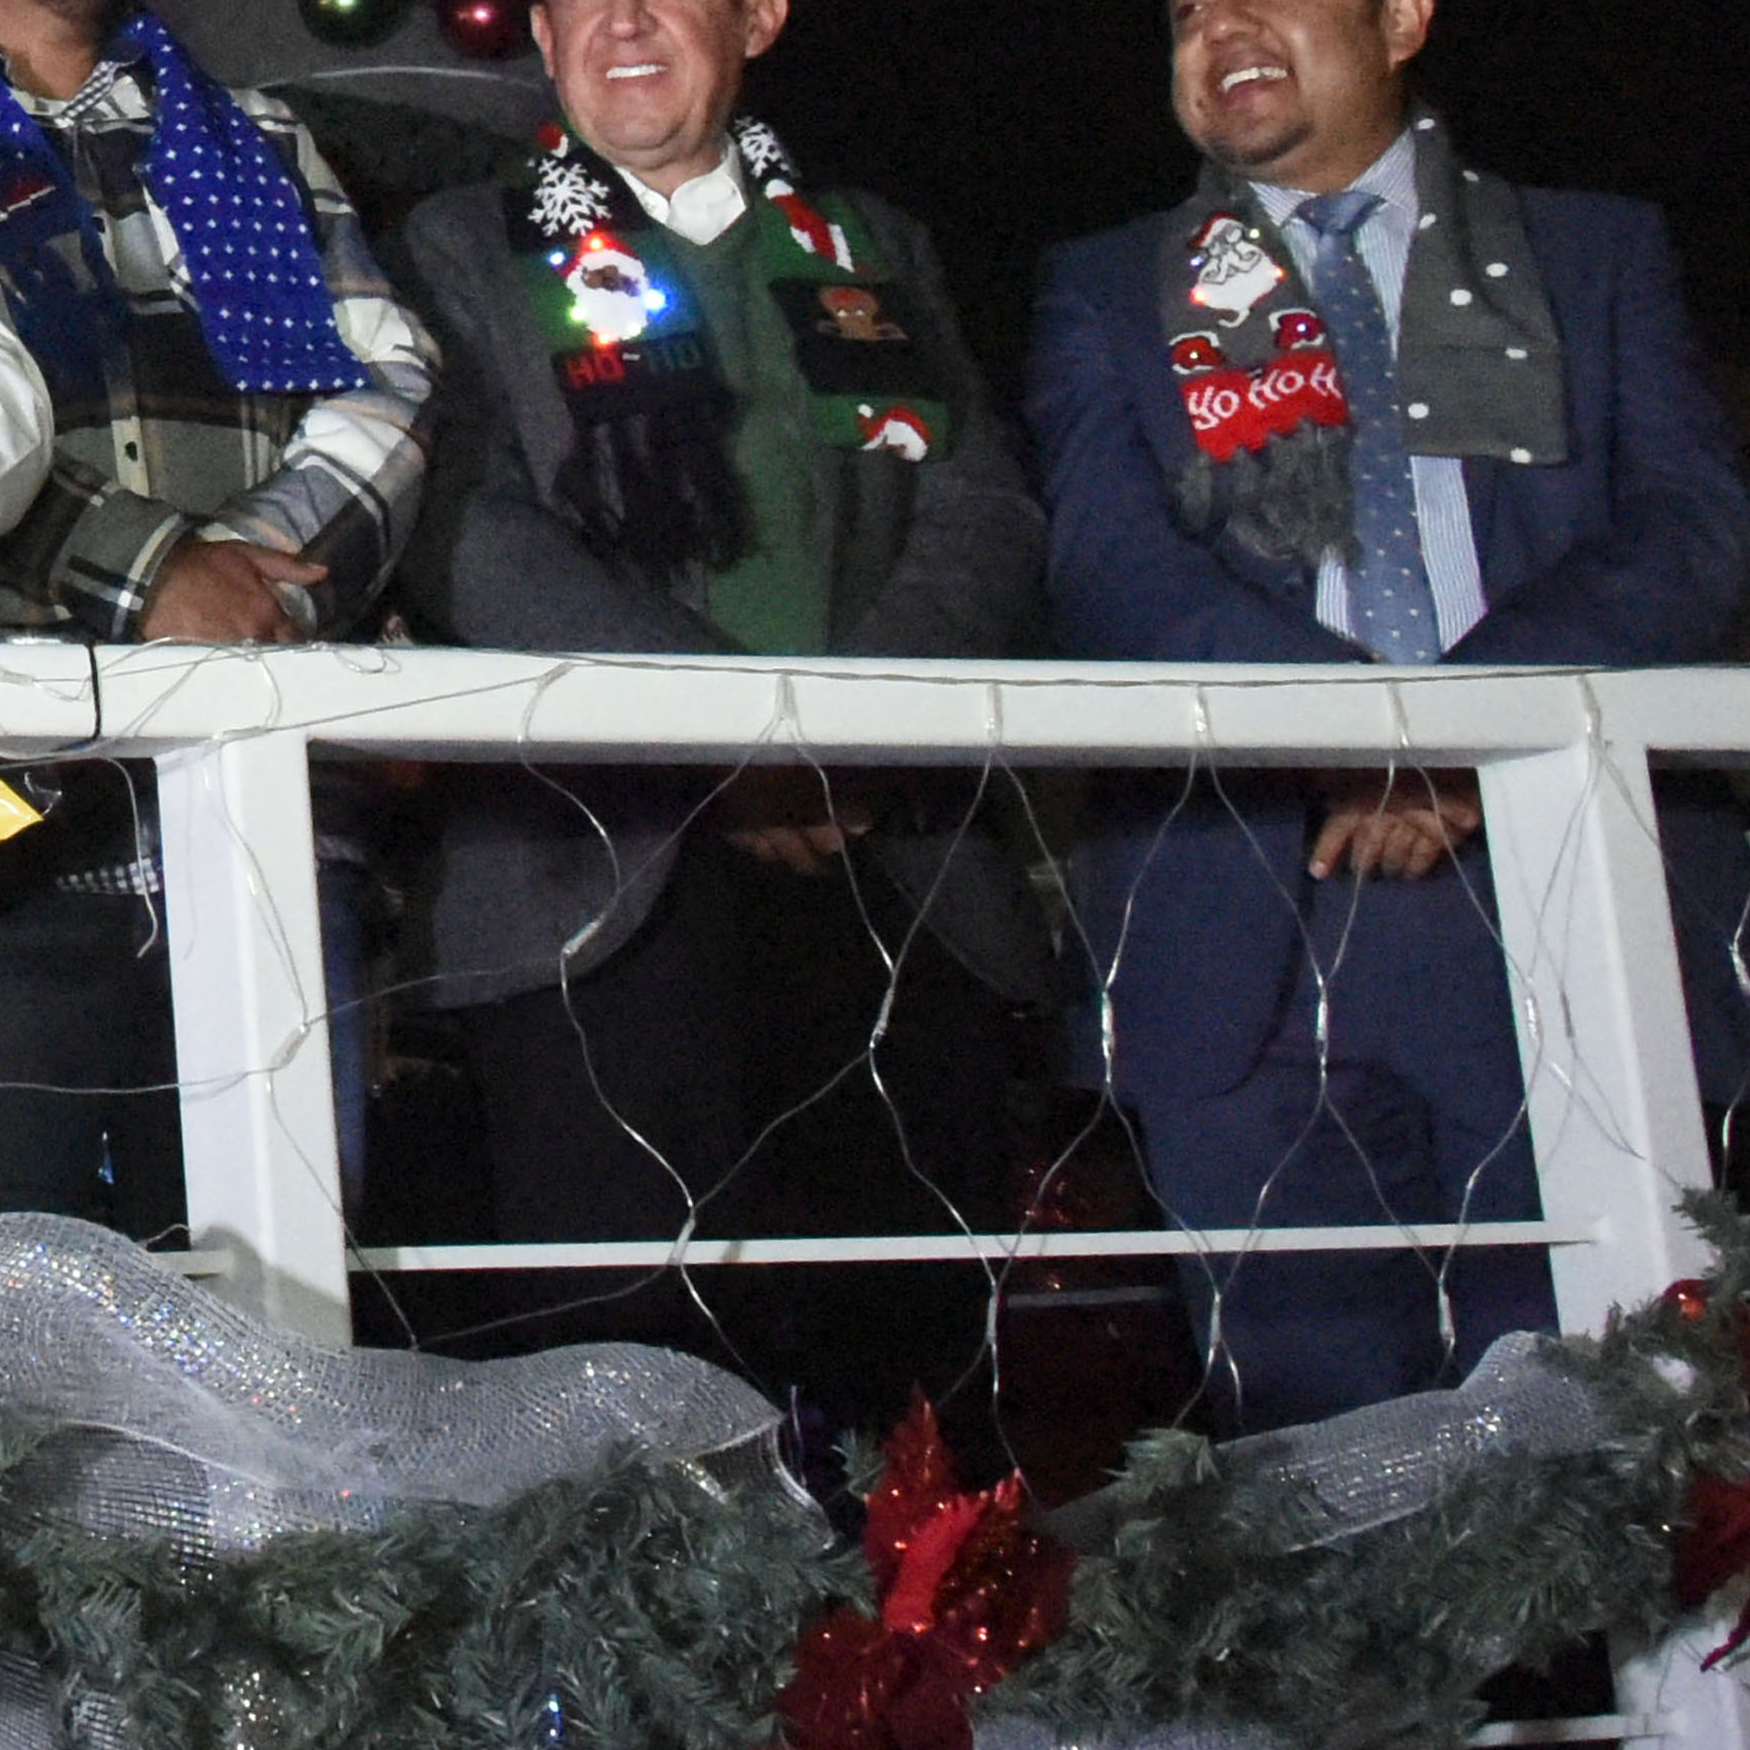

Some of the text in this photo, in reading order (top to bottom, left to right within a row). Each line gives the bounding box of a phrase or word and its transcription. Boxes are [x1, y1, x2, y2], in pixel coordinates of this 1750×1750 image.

[1187, 362, 1343, 431] YO HO H
